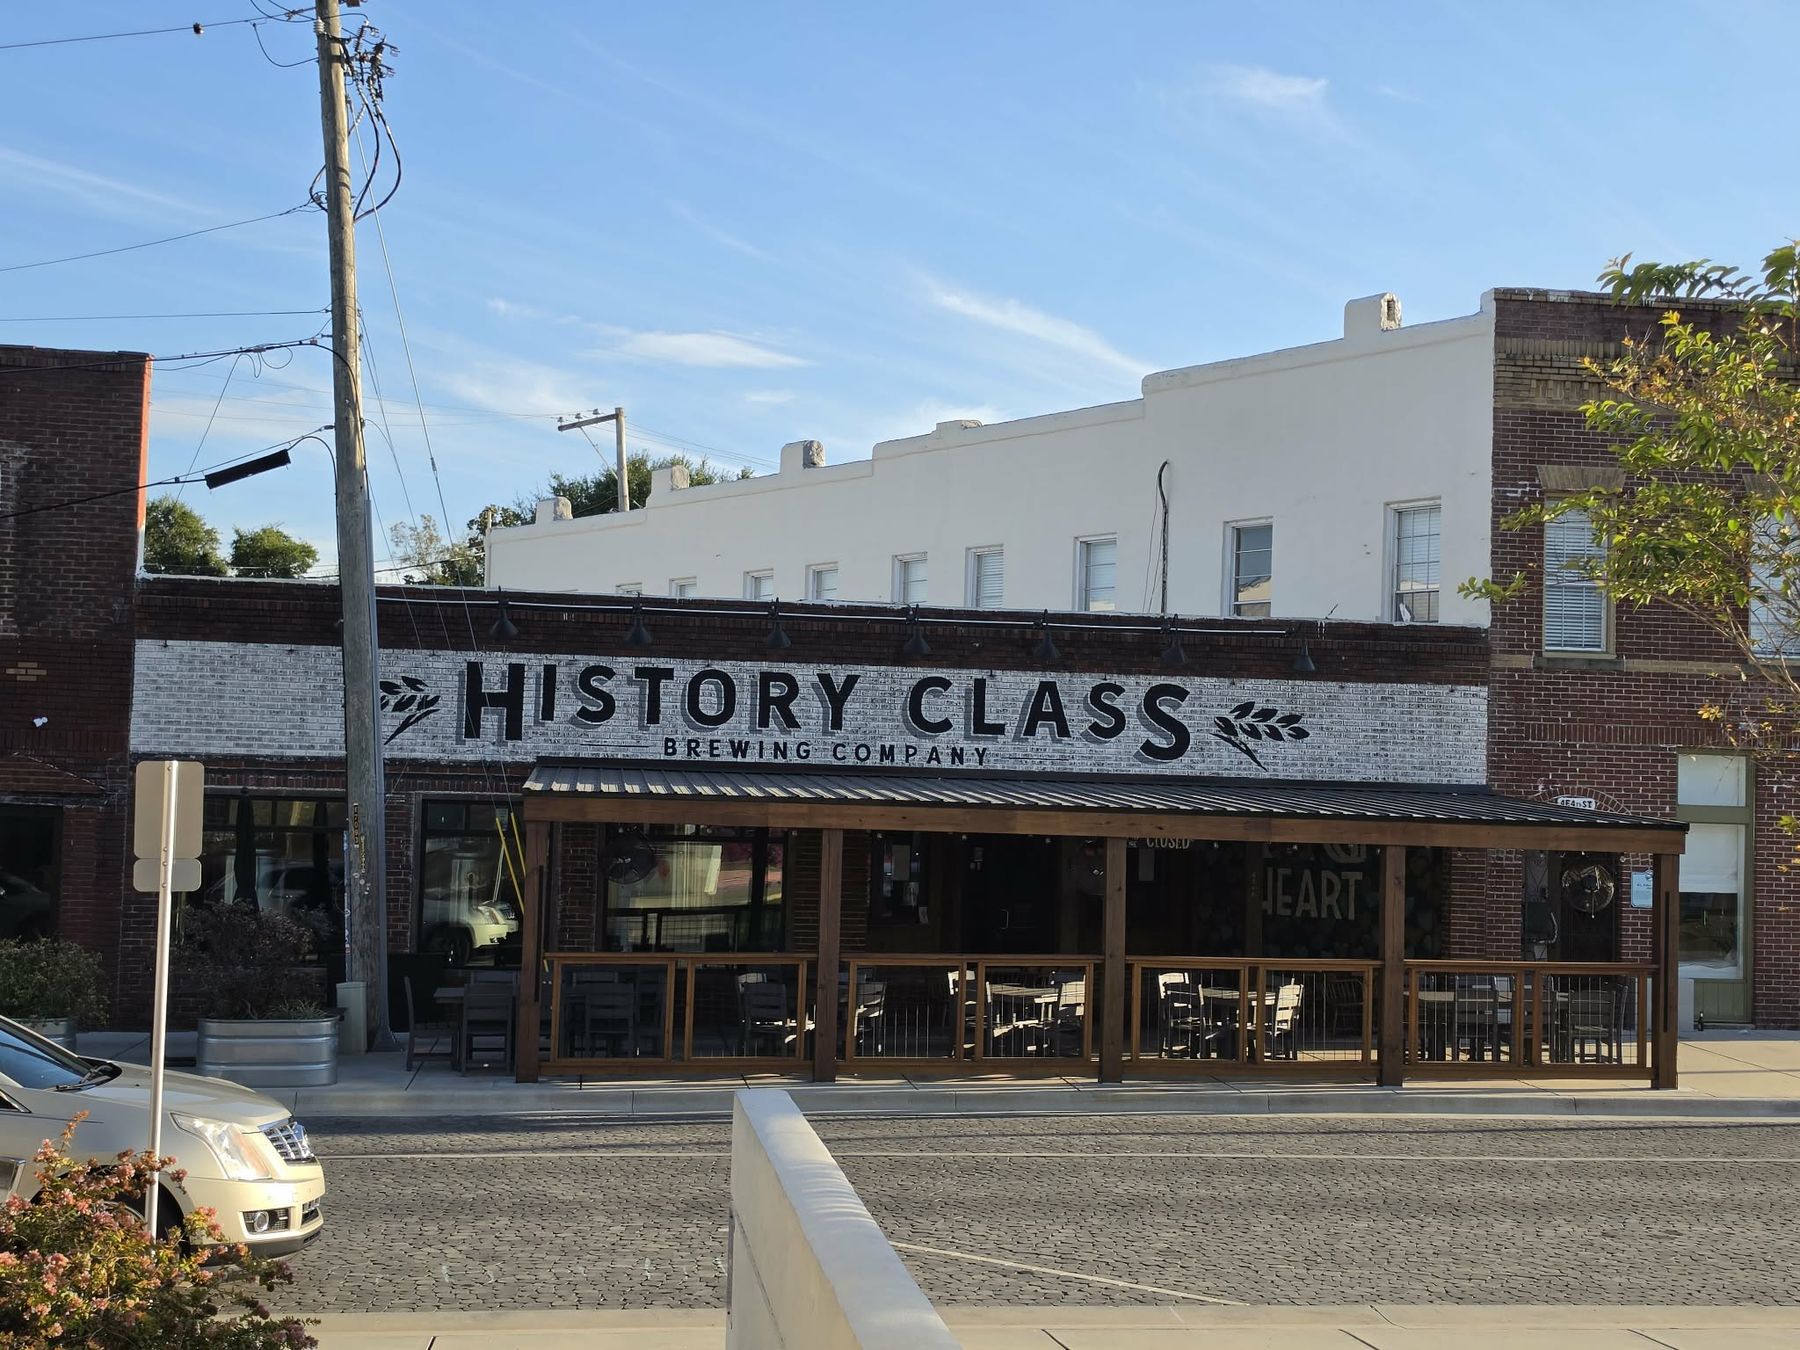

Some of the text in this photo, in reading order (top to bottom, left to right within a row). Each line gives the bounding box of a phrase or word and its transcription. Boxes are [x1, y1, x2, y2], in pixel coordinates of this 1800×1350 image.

[463, 661, 1191, 761] HISTORY CLASS
[664, 737, 989, 766] BREWING COMPANY
